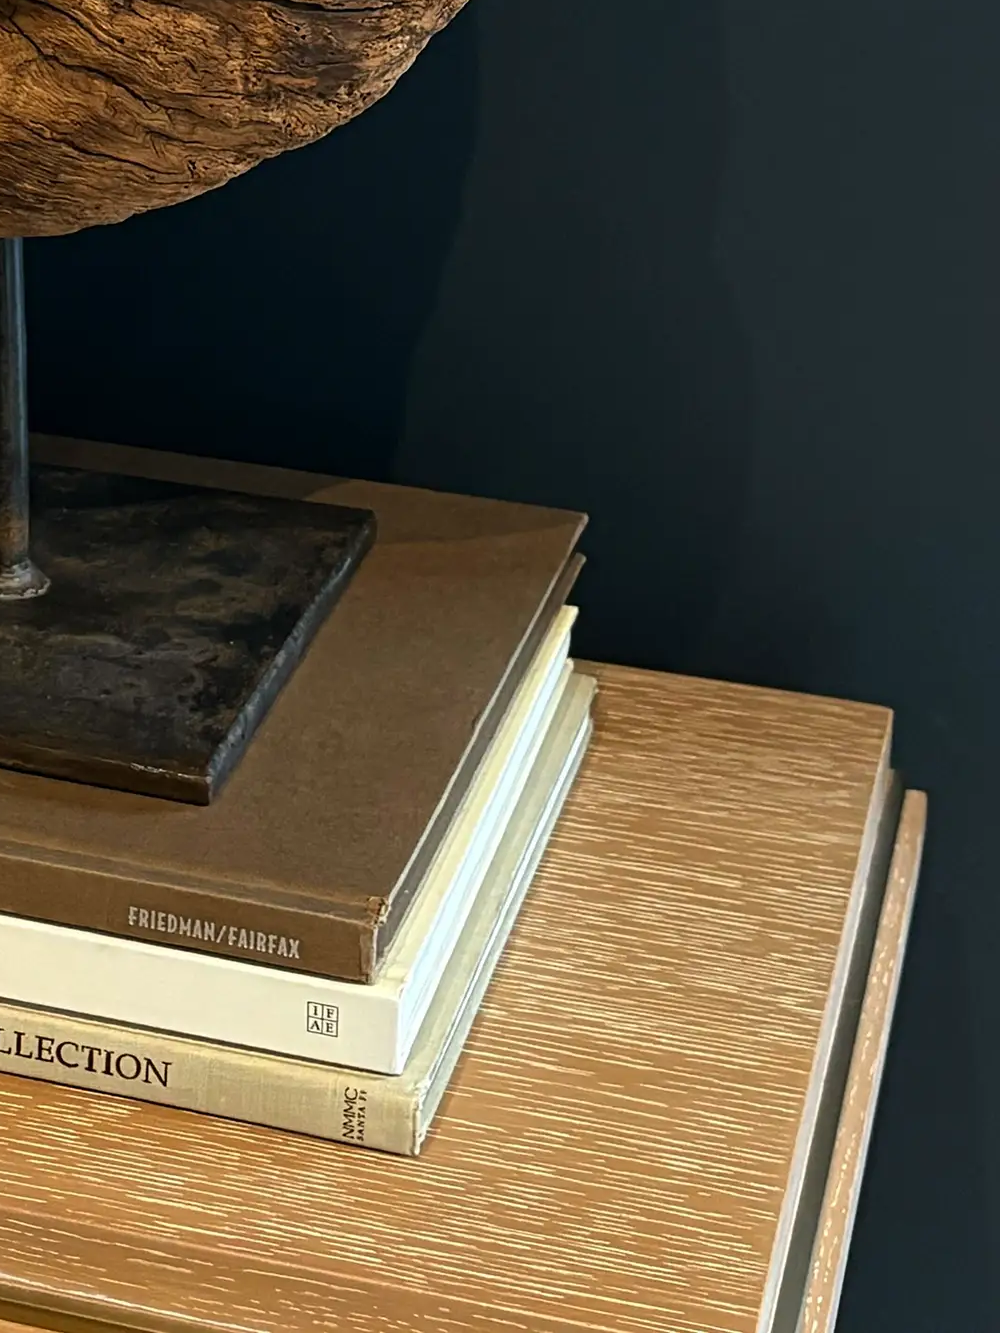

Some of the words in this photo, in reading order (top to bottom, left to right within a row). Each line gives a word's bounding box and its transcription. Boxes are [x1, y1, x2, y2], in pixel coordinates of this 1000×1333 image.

[128, 905, 301, 960] FRIEDMAN/FAIRFAX
[342, 1086, 359, 1140] NMMC
[356, 1107, 367, 1142] SANTA
